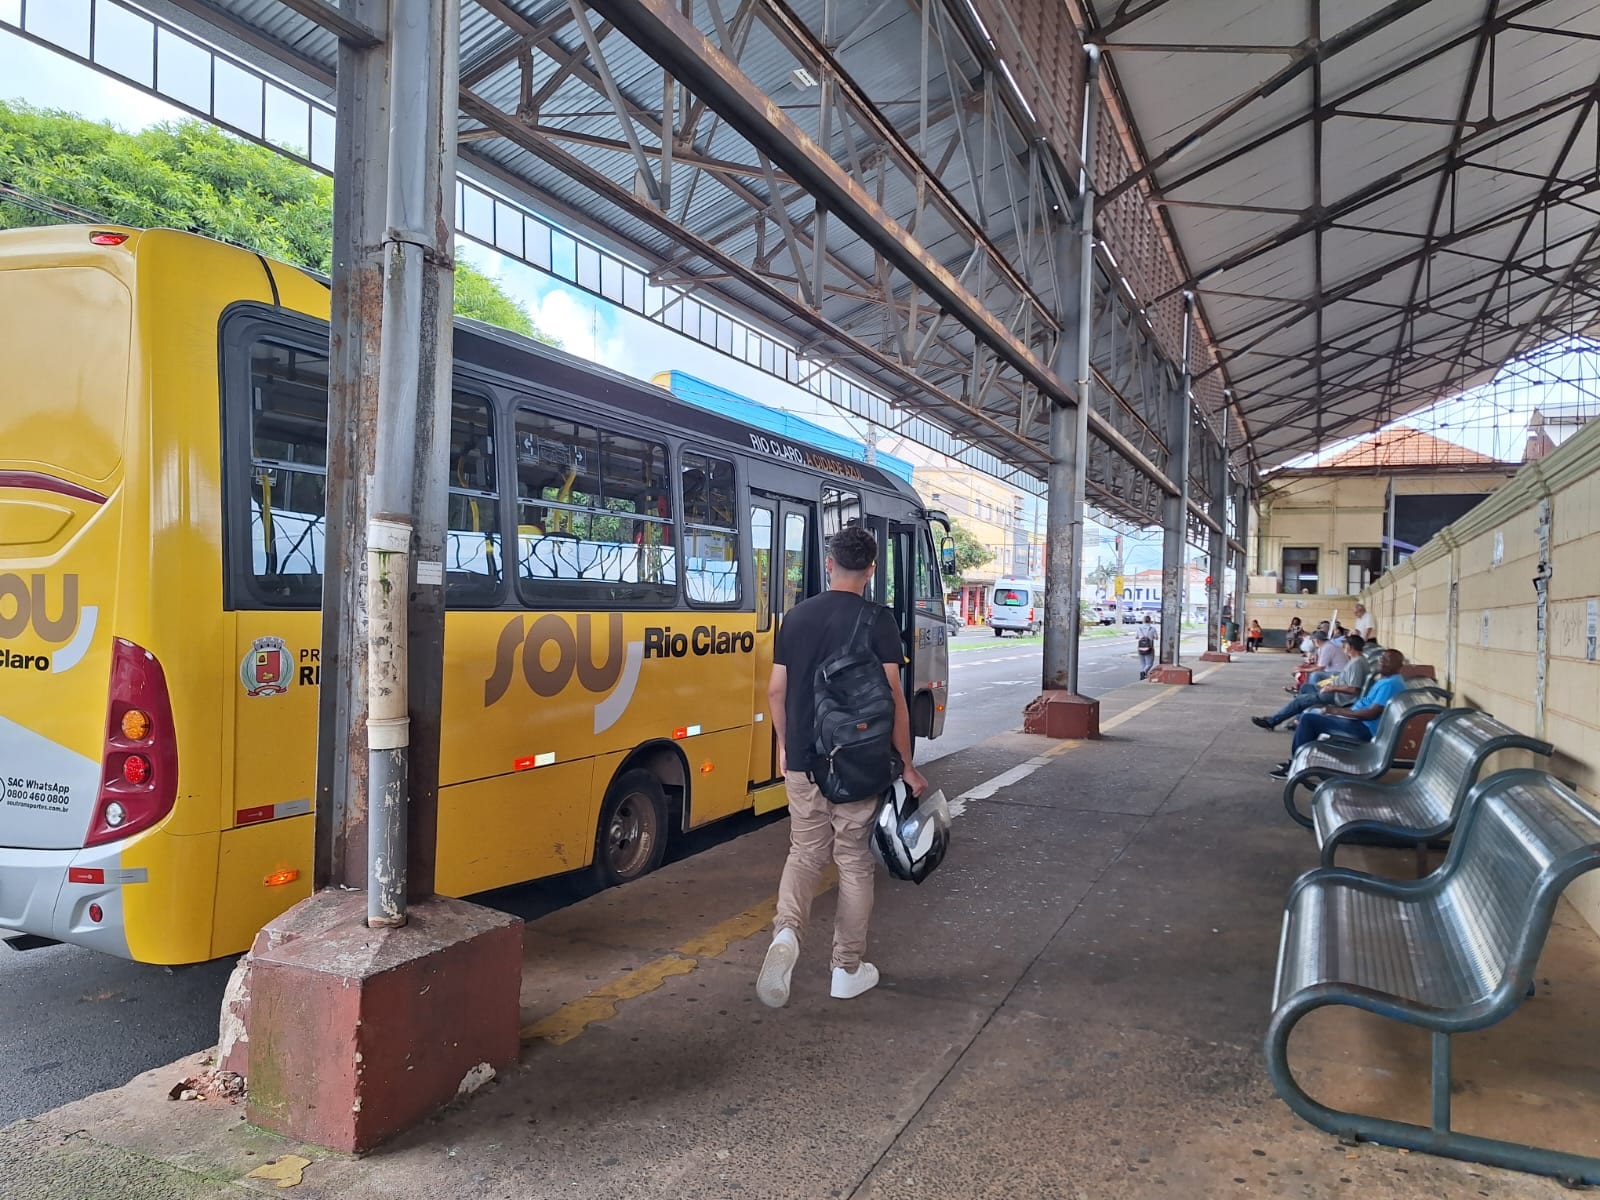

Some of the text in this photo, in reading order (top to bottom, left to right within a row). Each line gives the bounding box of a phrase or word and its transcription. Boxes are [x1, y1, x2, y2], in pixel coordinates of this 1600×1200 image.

[749, 433, 770, 454] RIO
[813, 455, 845, 475] CIDADE
[644, 625, 754, 659] Rio Claro
[0, 649, 50, 671] laro
[7, 777, 70, 795] SAC WhatsApp
[7, 789, 70, 805] 0800 460 0800
